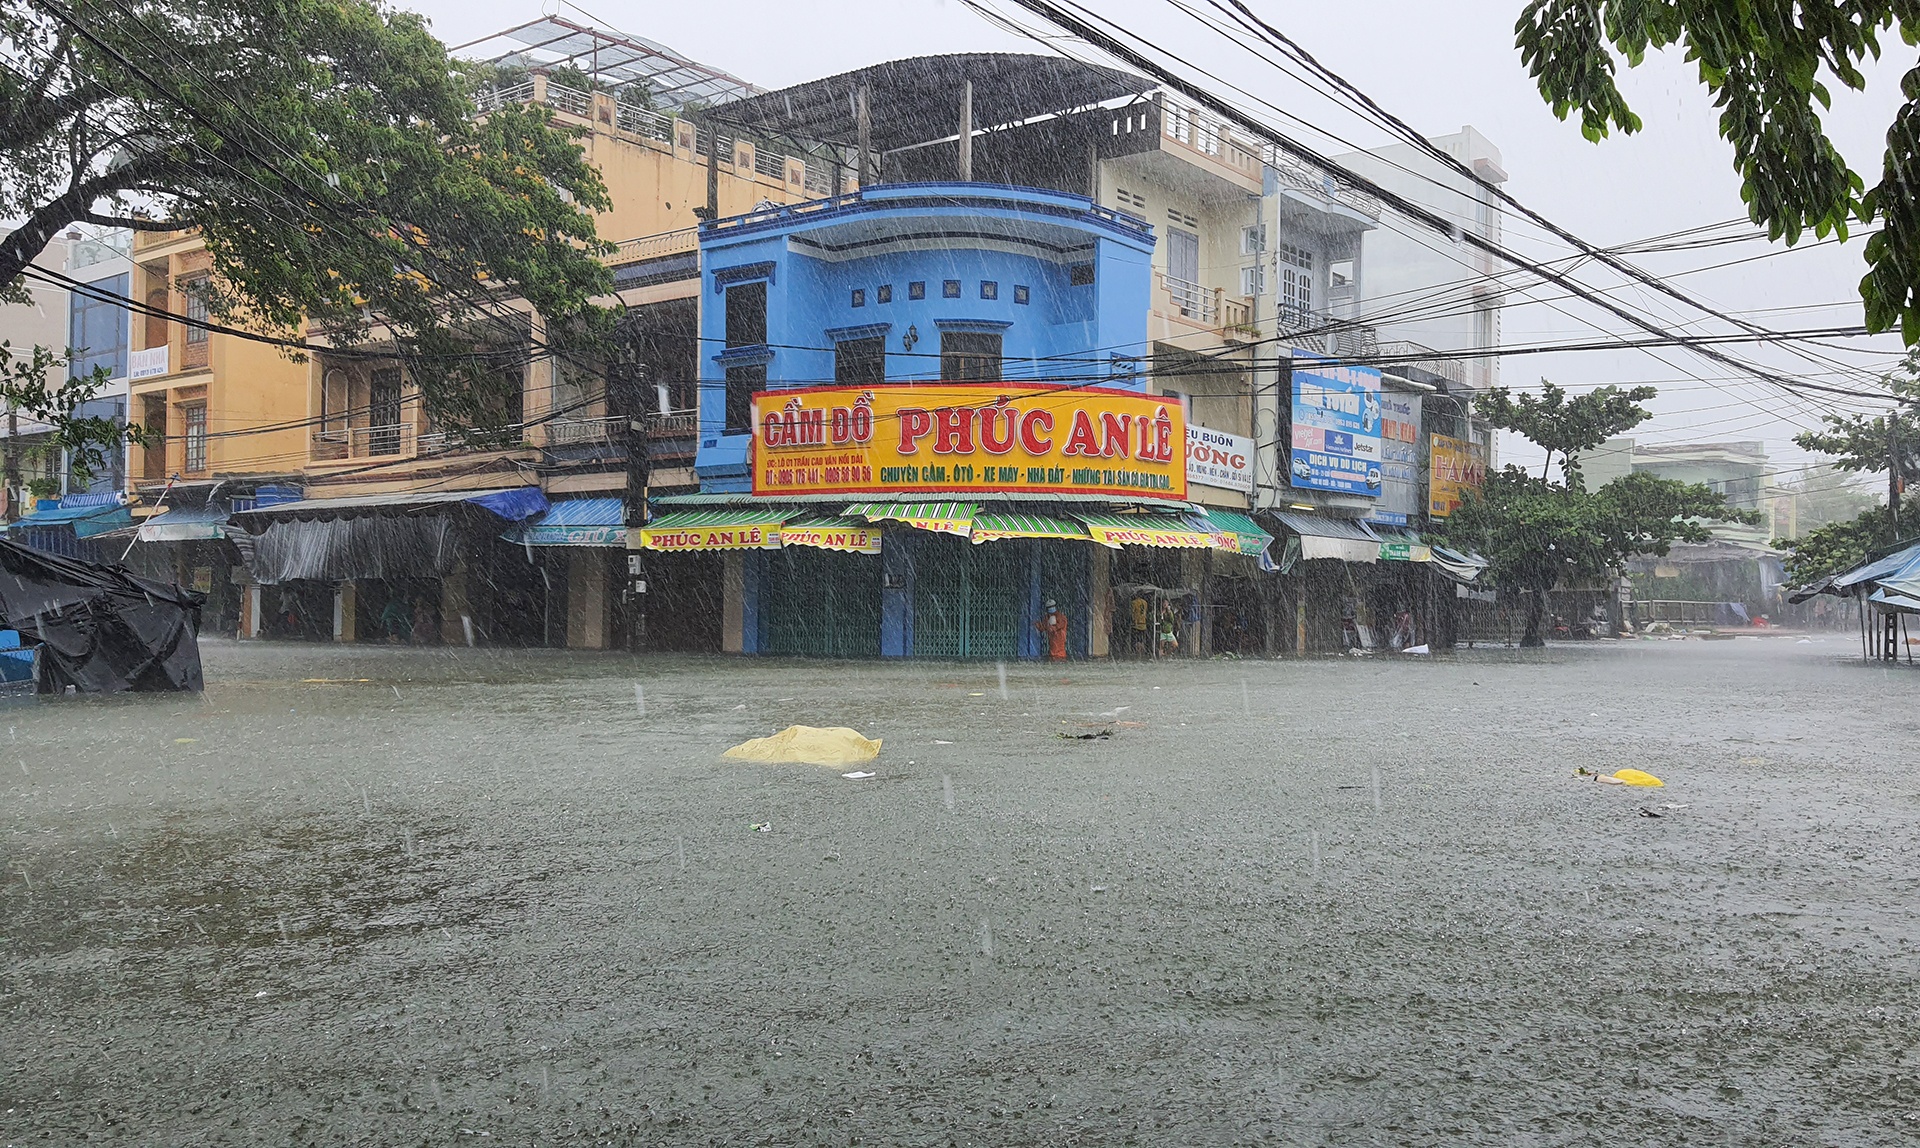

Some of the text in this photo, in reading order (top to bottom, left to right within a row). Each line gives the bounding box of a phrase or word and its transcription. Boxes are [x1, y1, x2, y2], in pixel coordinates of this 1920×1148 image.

[764, 391, 875, 447] CẦM ĐỒ
[896, 394, 1173, 464] PHÚC AN LÊ
[1202, 432, 1233, 447] BUÔN
[1354, 442, 1374, 453] Jetstar
[811, 456, 824, 466] CAO
[1309, 453, 1328, 467] DỊCH
[1329, 456, 1339, 469] VỤ
[1340, 458, 1351, 470] DU
[1352, 460, 1367, 472] LỊCH
[984, 466, 996, 482] XE
[998, 464, 1018, 483] MÁY
[1027, 465, 1045, 484] NHÀ
[1048, 463, 1065, 484] ĐẤT
[1072, 466, 1100, 486] NHỮNG
[568, 527, 610, 543] GIỮ
[651, 531, 700, 547] PHÚC
[706, 532, 734, 546] AN
[739, 527, 762, 544] LÊ
[781, 531, 820, 545] PHÚC
[823, 534, 846, 547] AN
[850, 530, 868, 547] LÊ
[1105, 530, 1151, 543] PHÚC
[1155, 534, 1180, 546] AN
